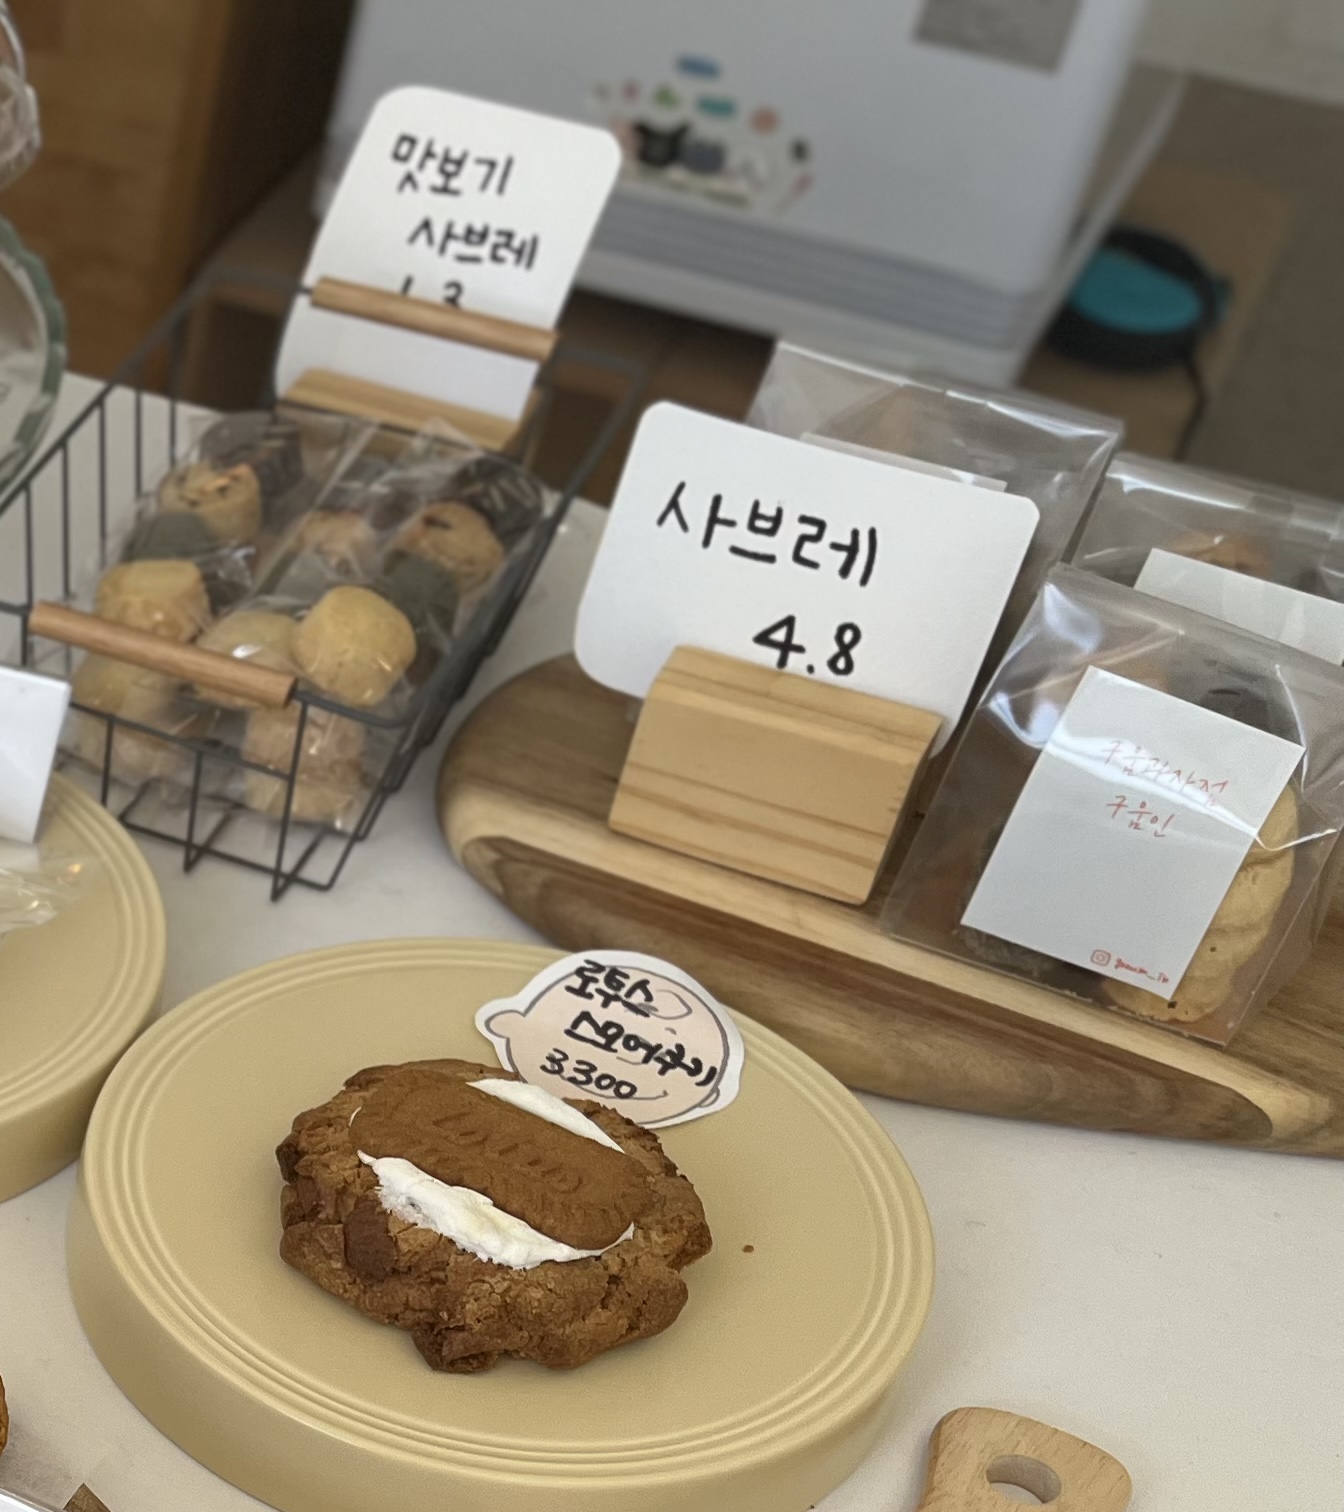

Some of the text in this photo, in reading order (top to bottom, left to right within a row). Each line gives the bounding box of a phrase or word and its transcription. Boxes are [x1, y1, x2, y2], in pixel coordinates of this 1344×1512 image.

[391, 133, 514, 195] 맛보기
[407, 217, 539, 270] 사브레
[657, 481, 877, 587] 사브레
[753, 615, 862, 676] 4.8
[540, 1047, 637, 1099] 3300
